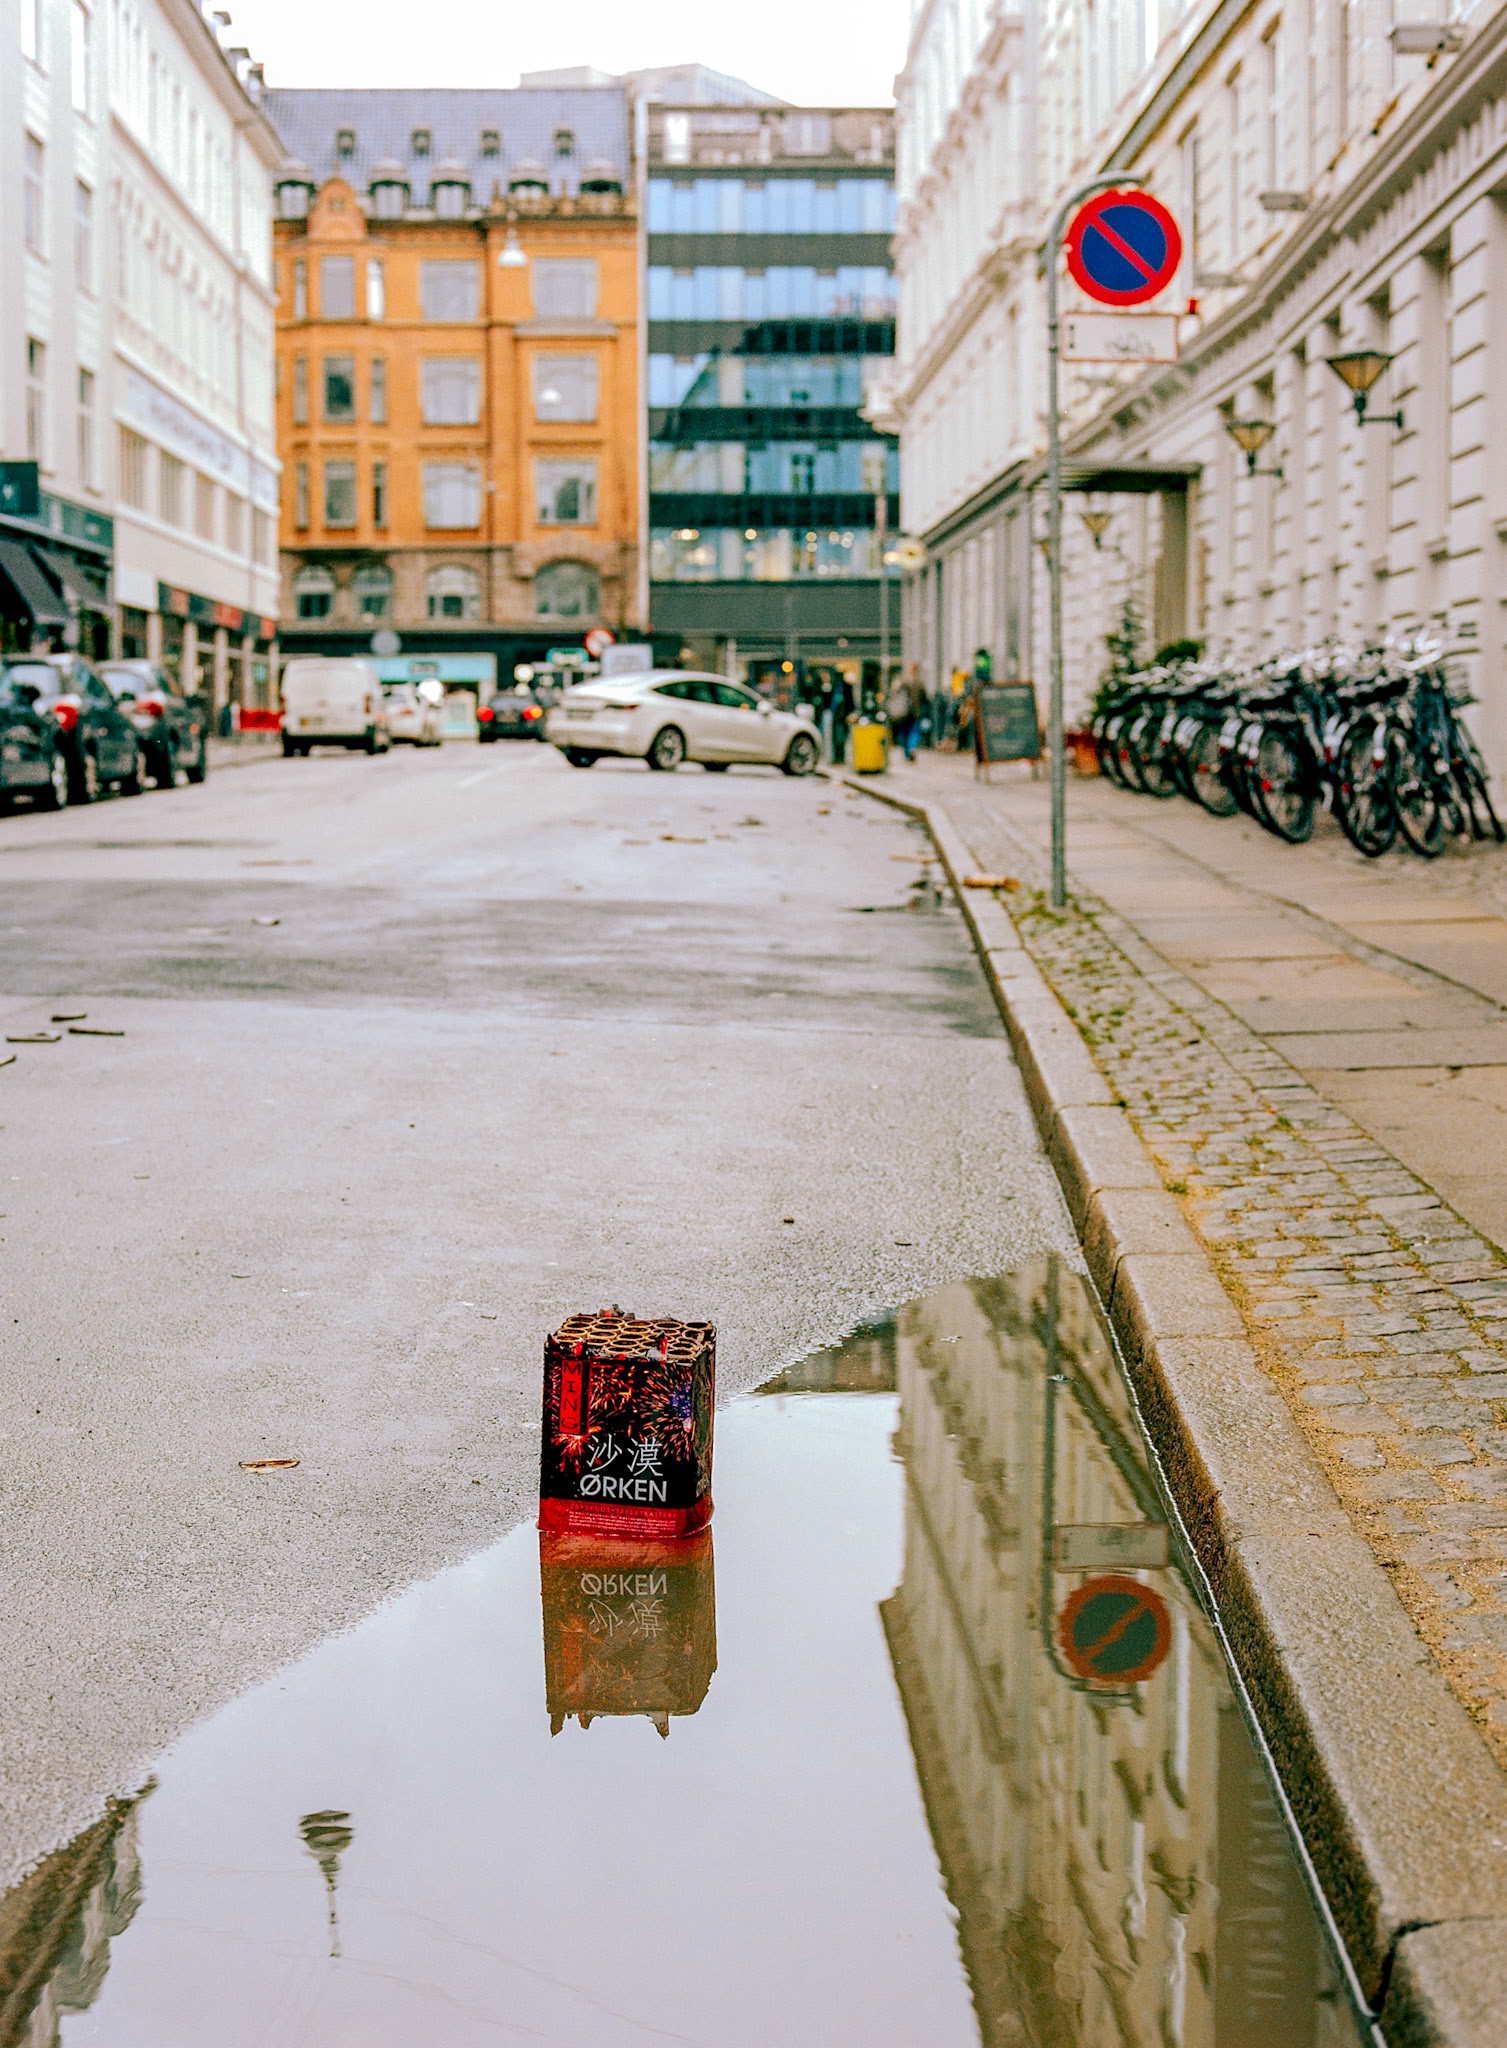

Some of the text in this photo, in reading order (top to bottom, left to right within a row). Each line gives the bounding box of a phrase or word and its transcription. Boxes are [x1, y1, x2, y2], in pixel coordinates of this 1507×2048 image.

[560, 1363, 581, 1429] MING
[586, 1433, 663, 1476] 沙漠
[580, 1474, 667, 1502] ØRKEN
